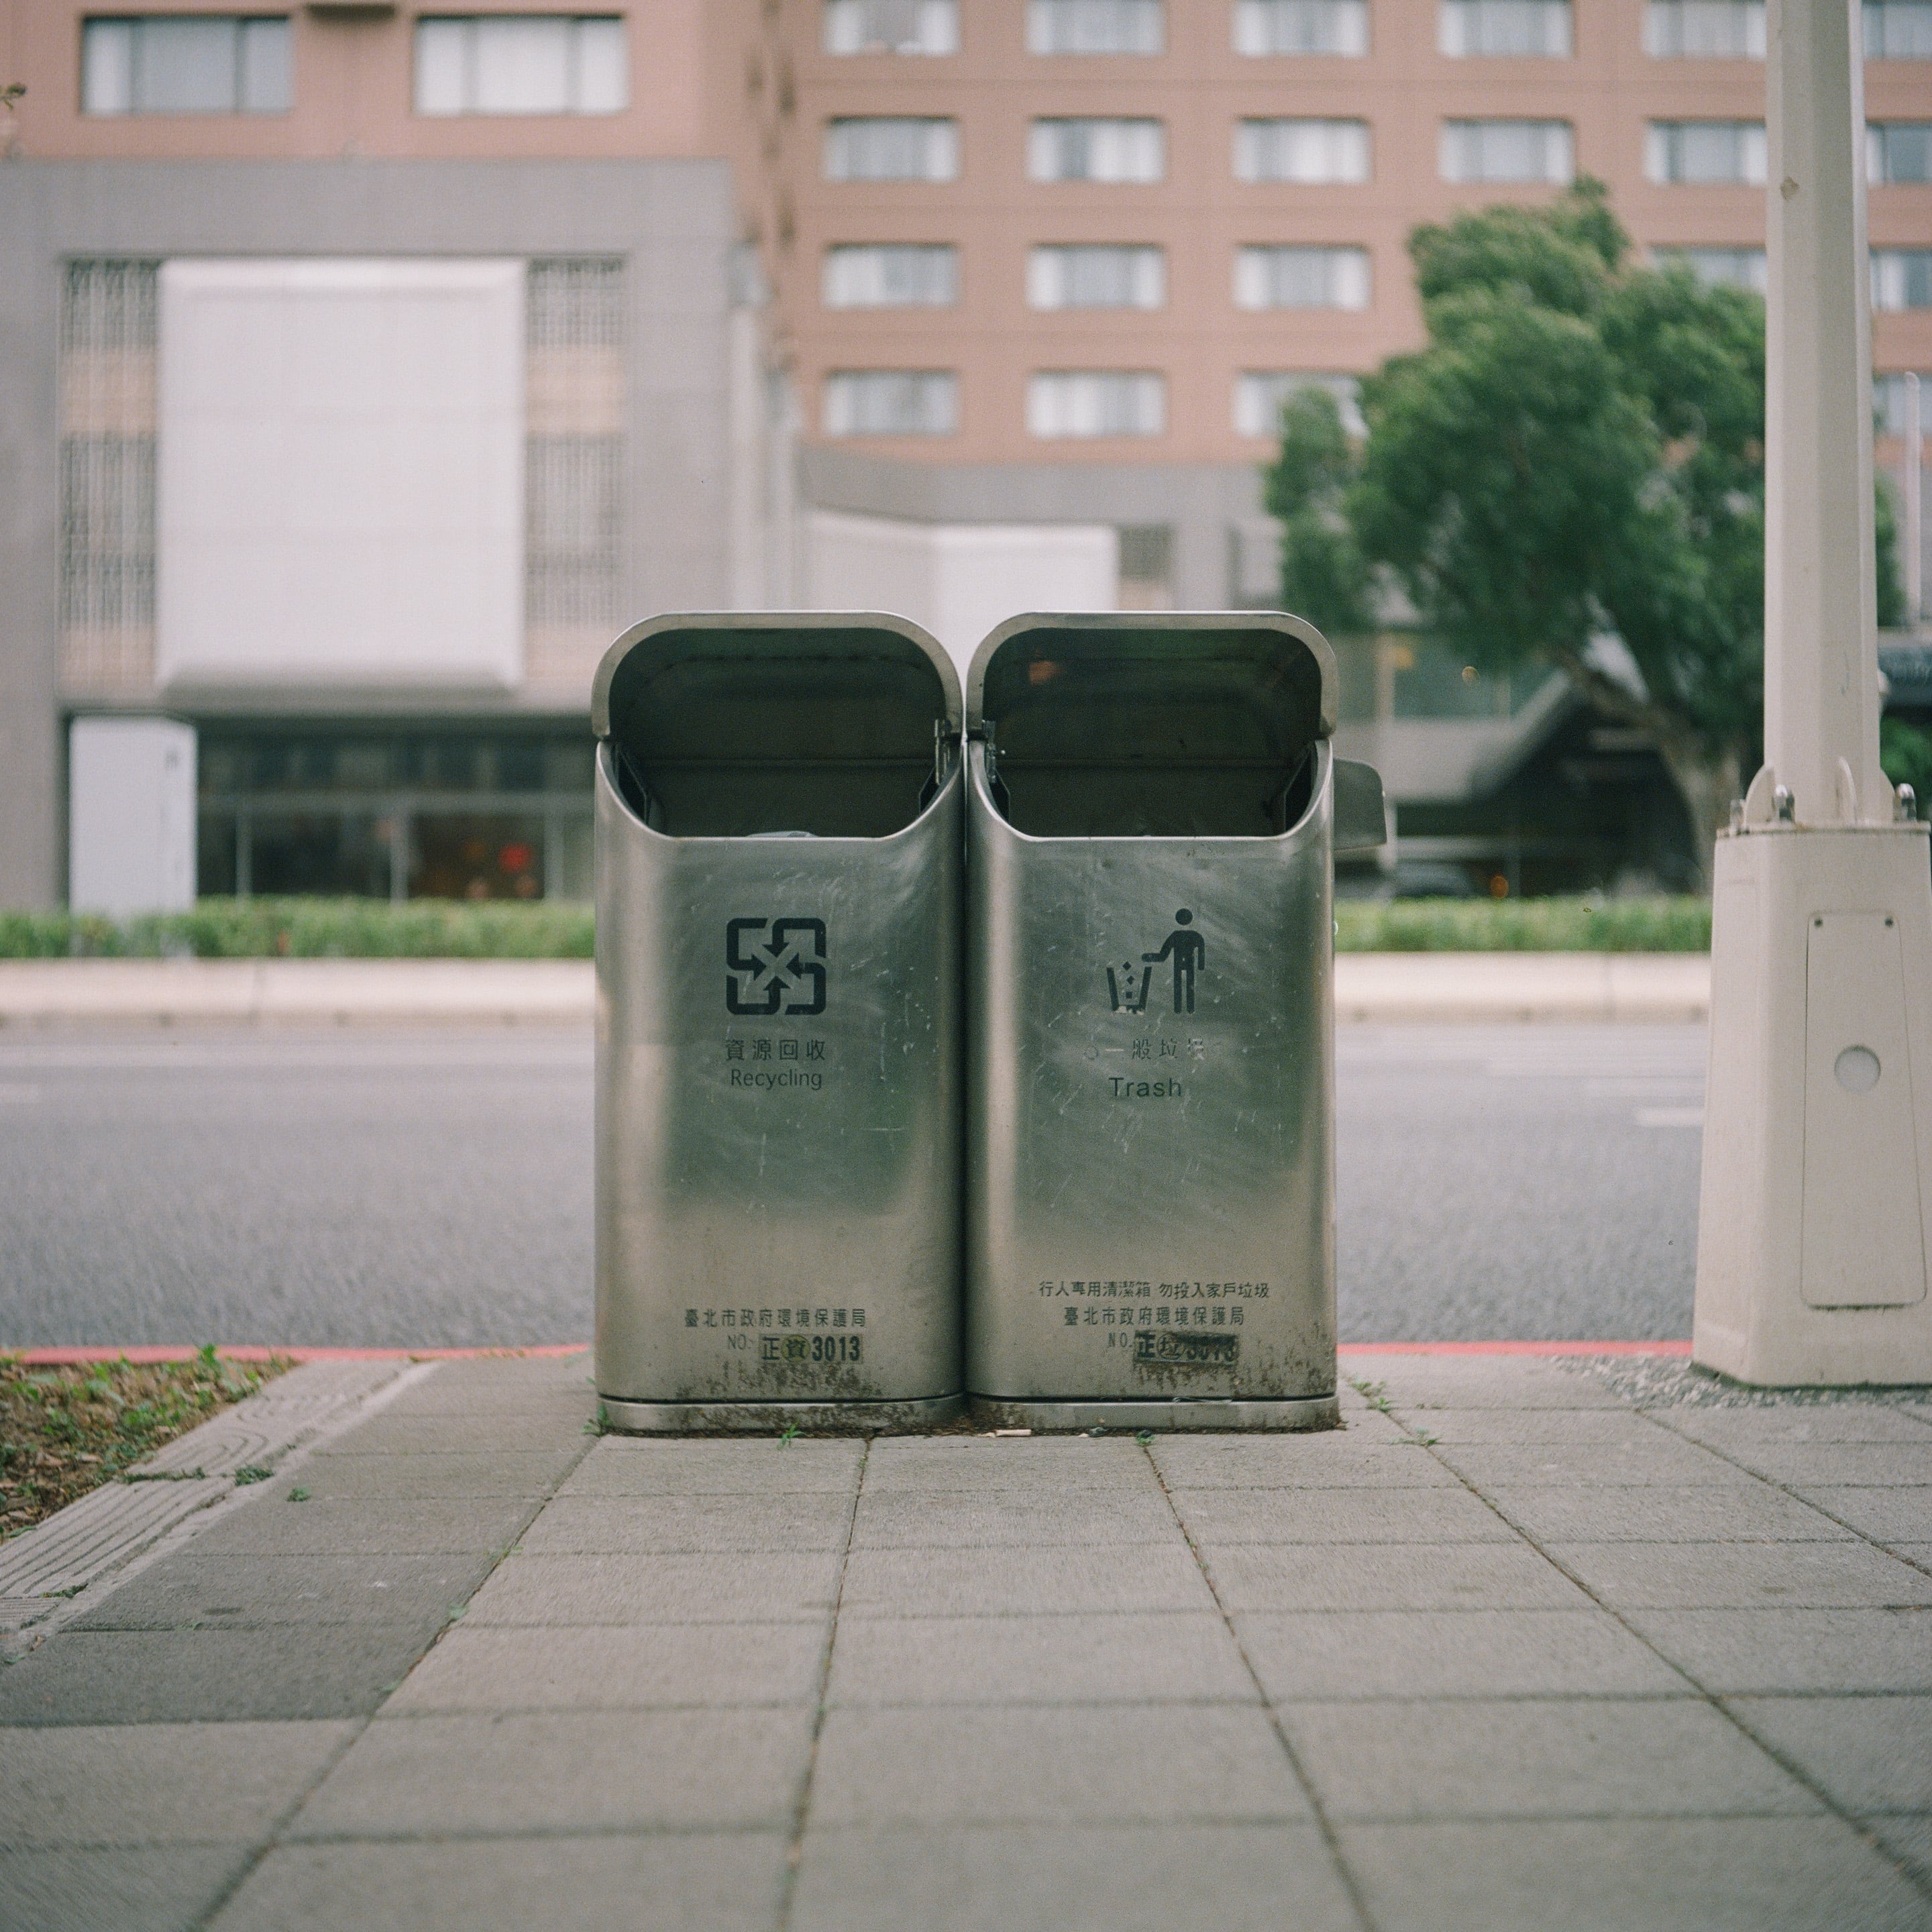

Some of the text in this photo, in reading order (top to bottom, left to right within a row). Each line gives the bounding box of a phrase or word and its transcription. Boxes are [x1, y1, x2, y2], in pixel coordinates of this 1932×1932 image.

[725, 1039, 826, 1061] 資源回收
[731, 1069, 822, 1091] Recycling
[1108, 1077, 1182, 1097] Trash
[684, 1308, 866, 1328] 臺北市政府環境保護局
[1064, 1306, 1244, 1327] 臺北市政府環境保護局
